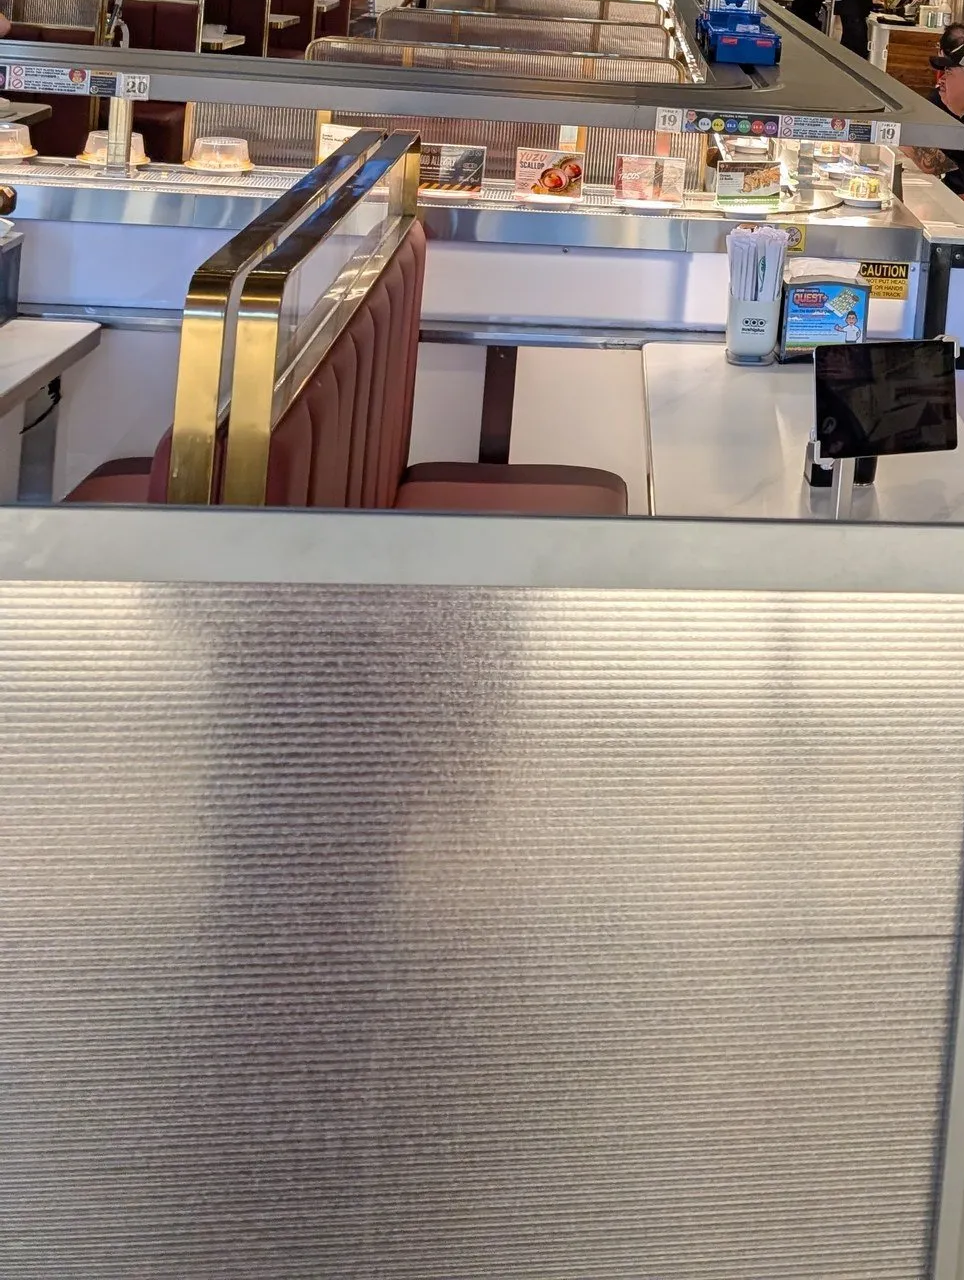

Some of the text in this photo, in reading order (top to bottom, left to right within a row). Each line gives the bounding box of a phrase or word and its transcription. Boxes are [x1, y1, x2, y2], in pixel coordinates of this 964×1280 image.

[126, 80, 148, 94] 20
[660, 114, 678, 127] 19
[880, 128, 895, 140] 19
[520, 151, 548, 162] YUZU
[519, 161, 545, 170] SCALLOP
[618, 172, 641, 180] TACOS
[860, 264, 907, 278] CAUTION
